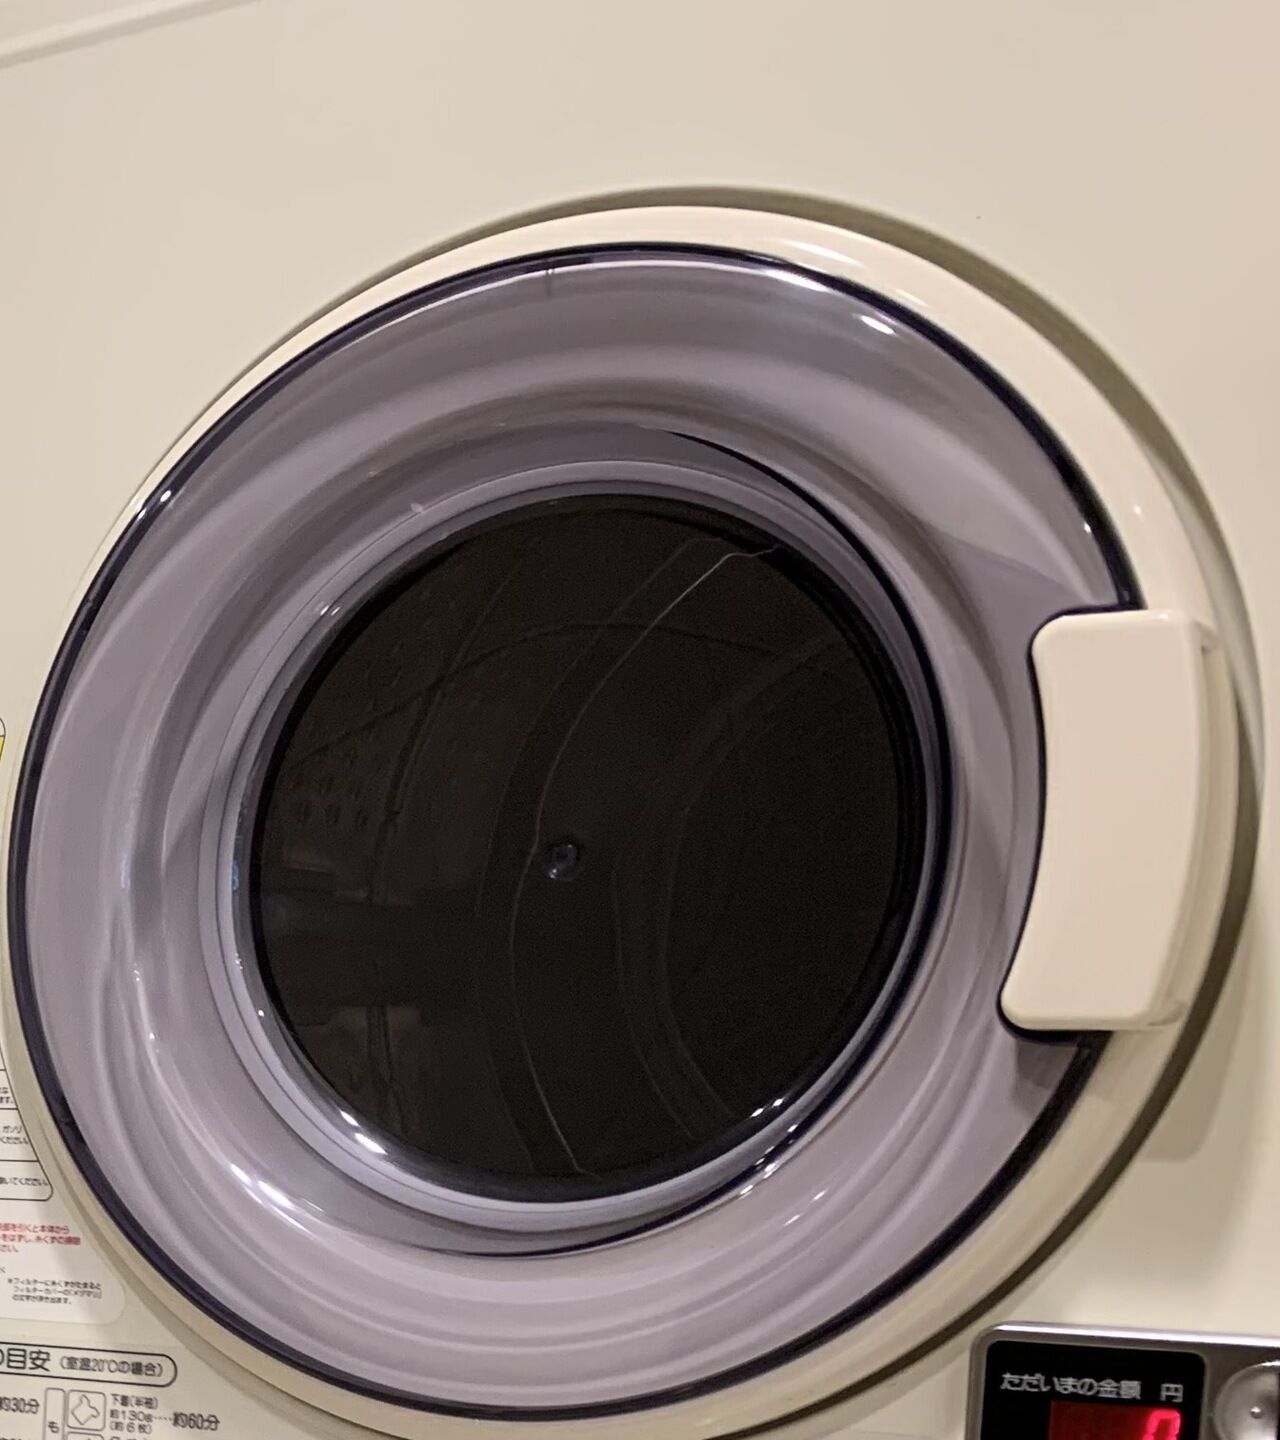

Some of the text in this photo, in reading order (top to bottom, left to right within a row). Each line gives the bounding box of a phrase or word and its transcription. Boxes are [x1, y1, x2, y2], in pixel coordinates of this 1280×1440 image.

[999, 1373, 1184, 1403] ただいまの金額 円
